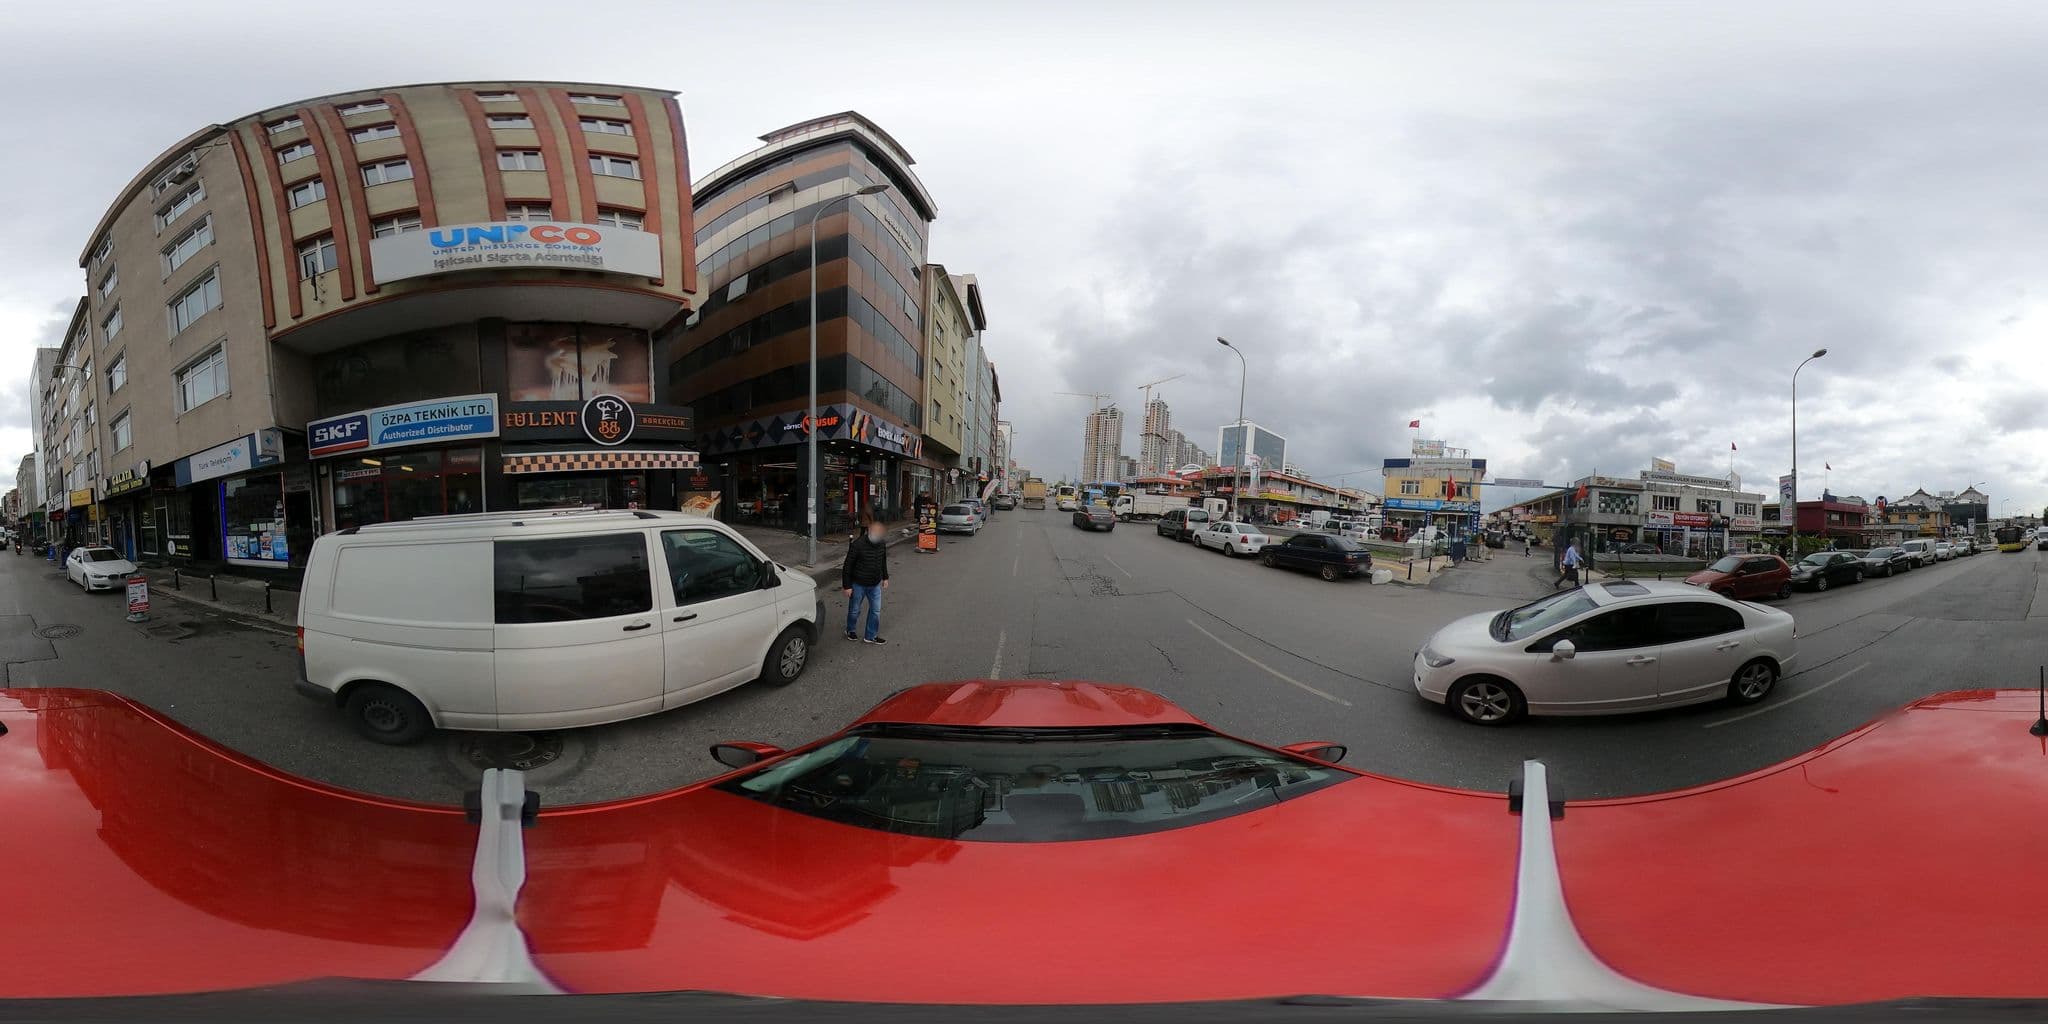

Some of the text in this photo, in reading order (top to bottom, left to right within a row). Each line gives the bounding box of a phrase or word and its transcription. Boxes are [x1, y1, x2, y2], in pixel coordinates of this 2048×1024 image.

[433, 245, 475, 255] UNITED
[544, 244, 601, 252] COMPANY
[381, 404, 490, 426] ÖZPA TEKNİK LTD.
[314, 421, 361, 443] SKF
[383, 422, 473, 441] Authorized Distributor
